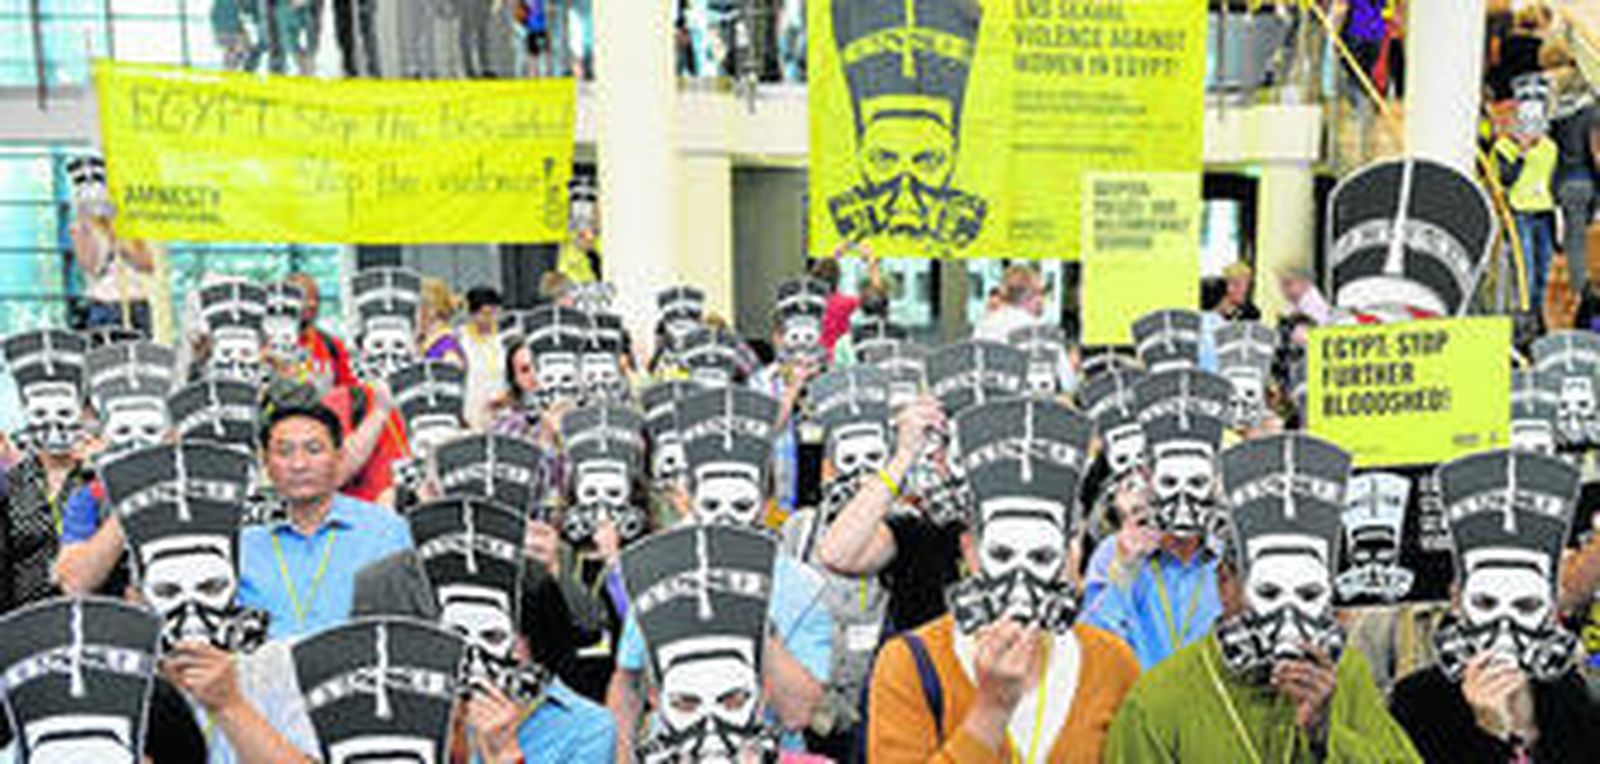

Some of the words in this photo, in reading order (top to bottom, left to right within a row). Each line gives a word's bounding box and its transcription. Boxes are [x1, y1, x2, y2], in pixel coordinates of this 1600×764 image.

[1396, 329, 1450, 358] STOP
[1322, 361, 1415, 389] FURTHER
[1323, 385, 1453, 417] BLOODSHED!
